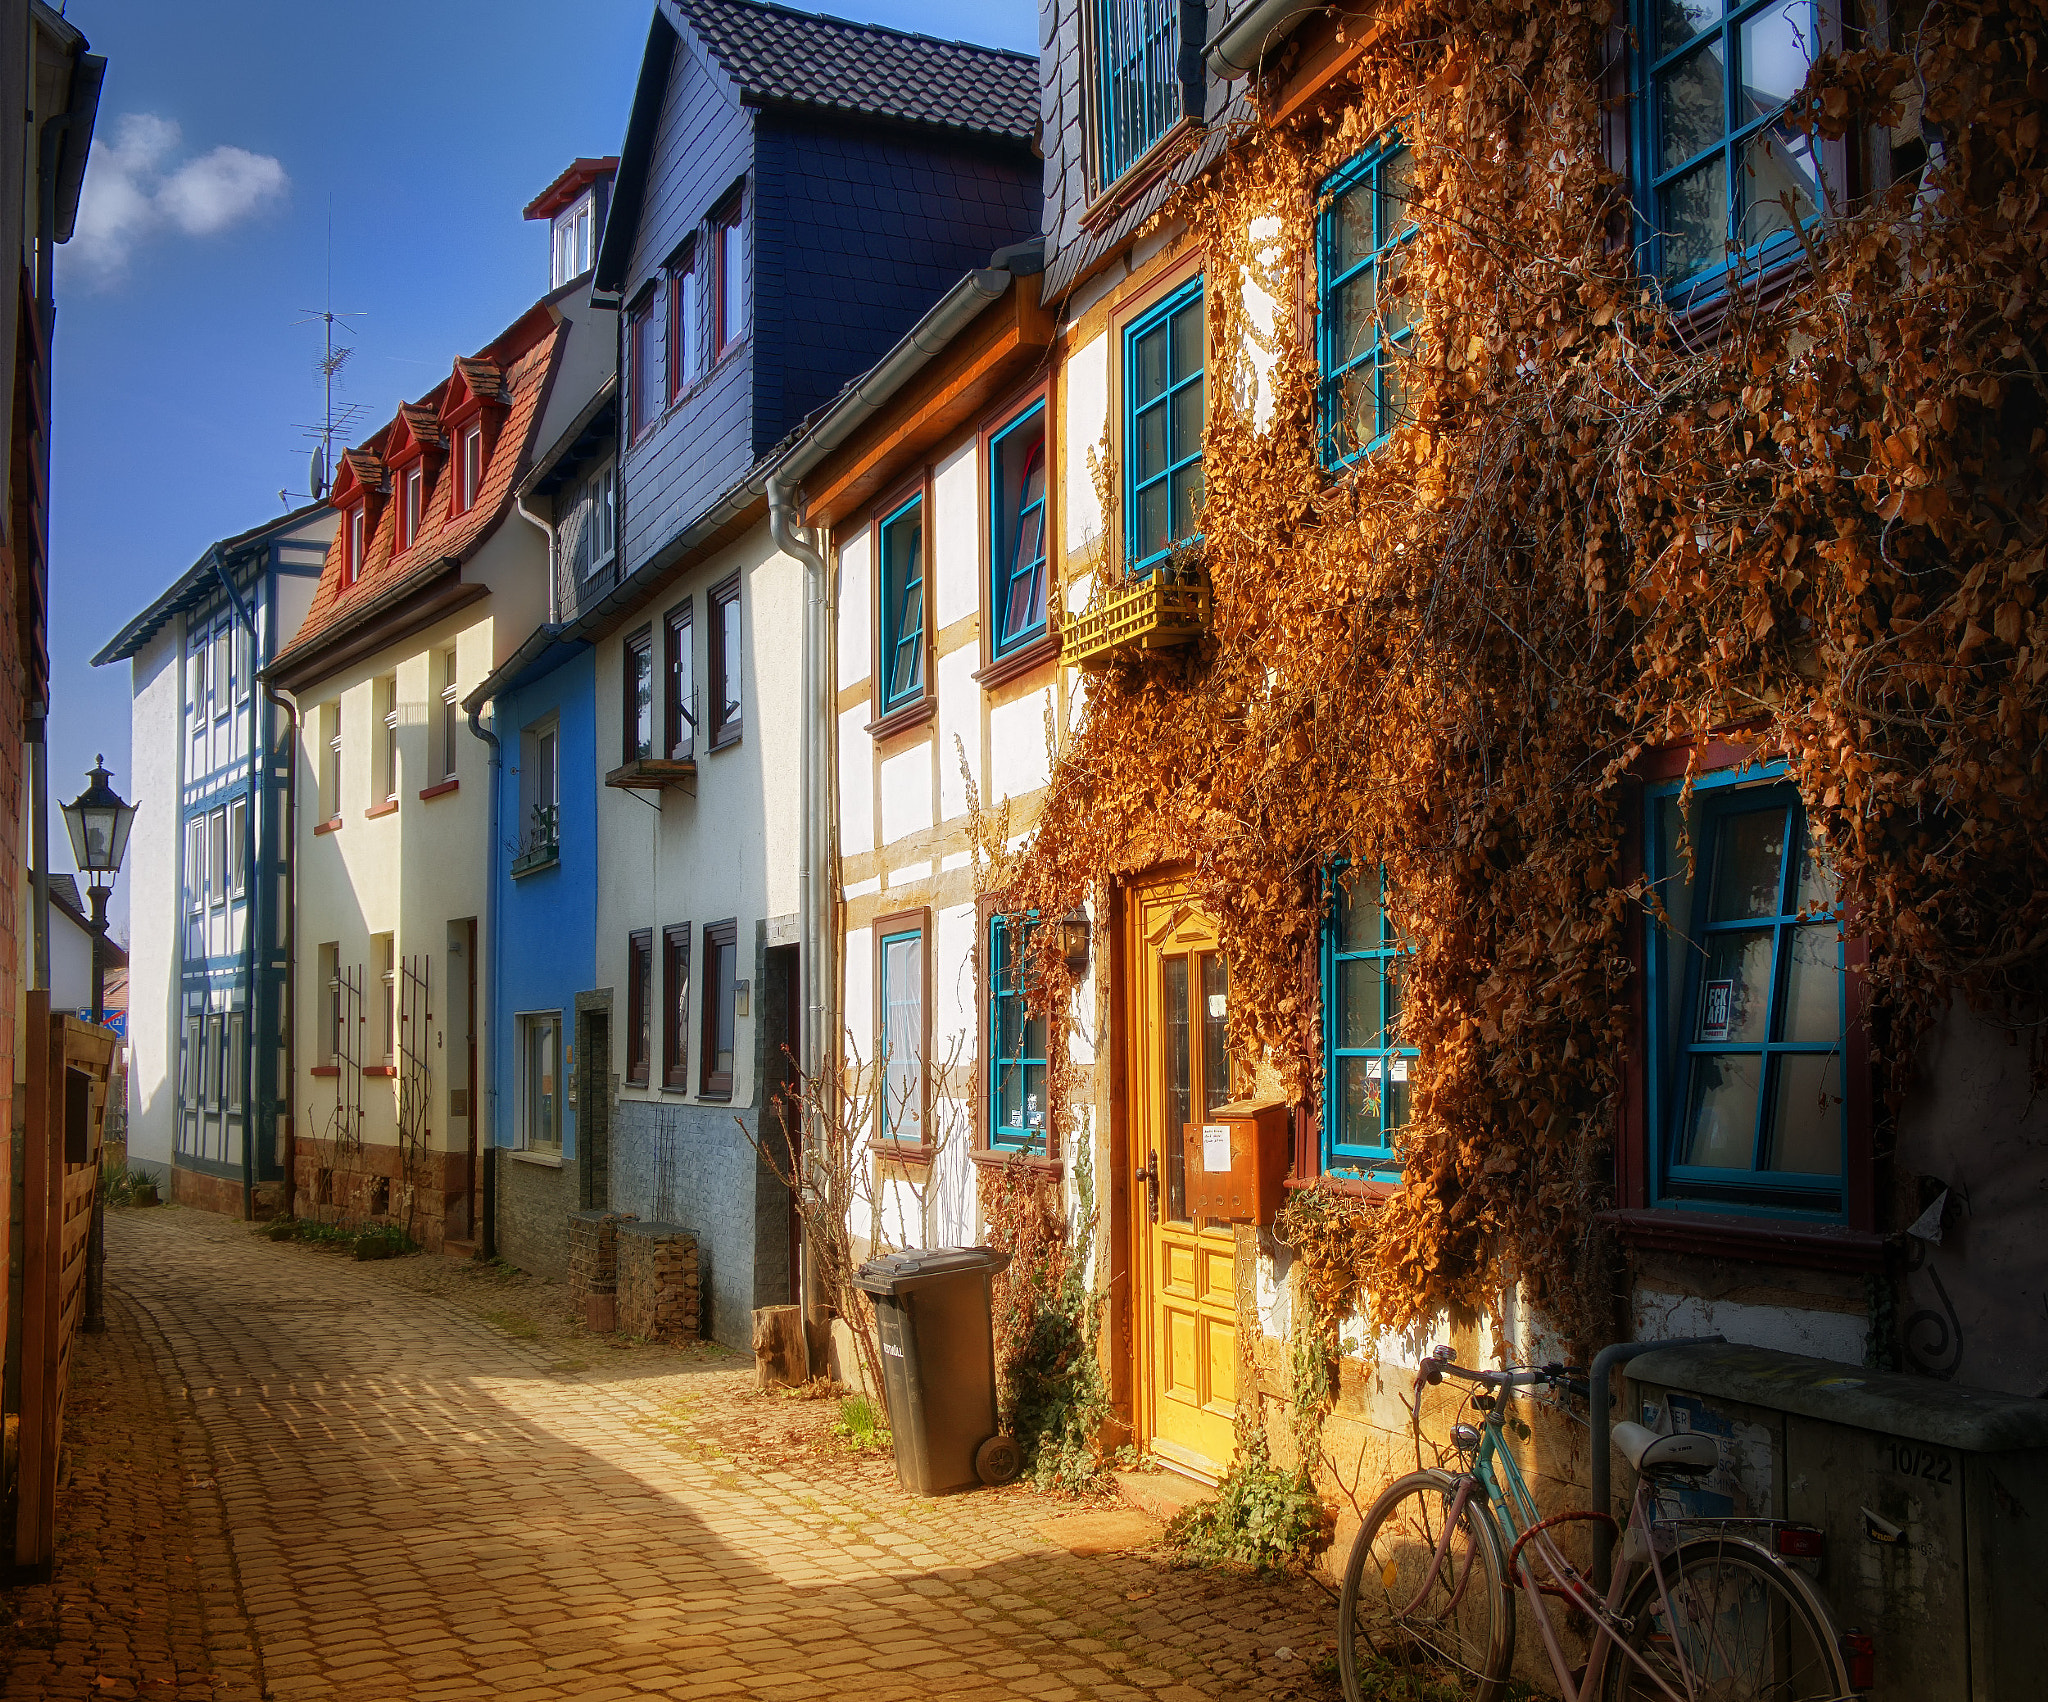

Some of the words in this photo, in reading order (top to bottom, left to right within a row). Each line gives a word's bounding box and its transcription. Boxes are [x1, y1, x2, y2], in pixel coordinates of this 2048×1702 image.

[1708, 988, 1728, 1006] FCK
[437, 1030, 443, 1049] 3
[1887, 1443, 1952, 1486] 10/22
